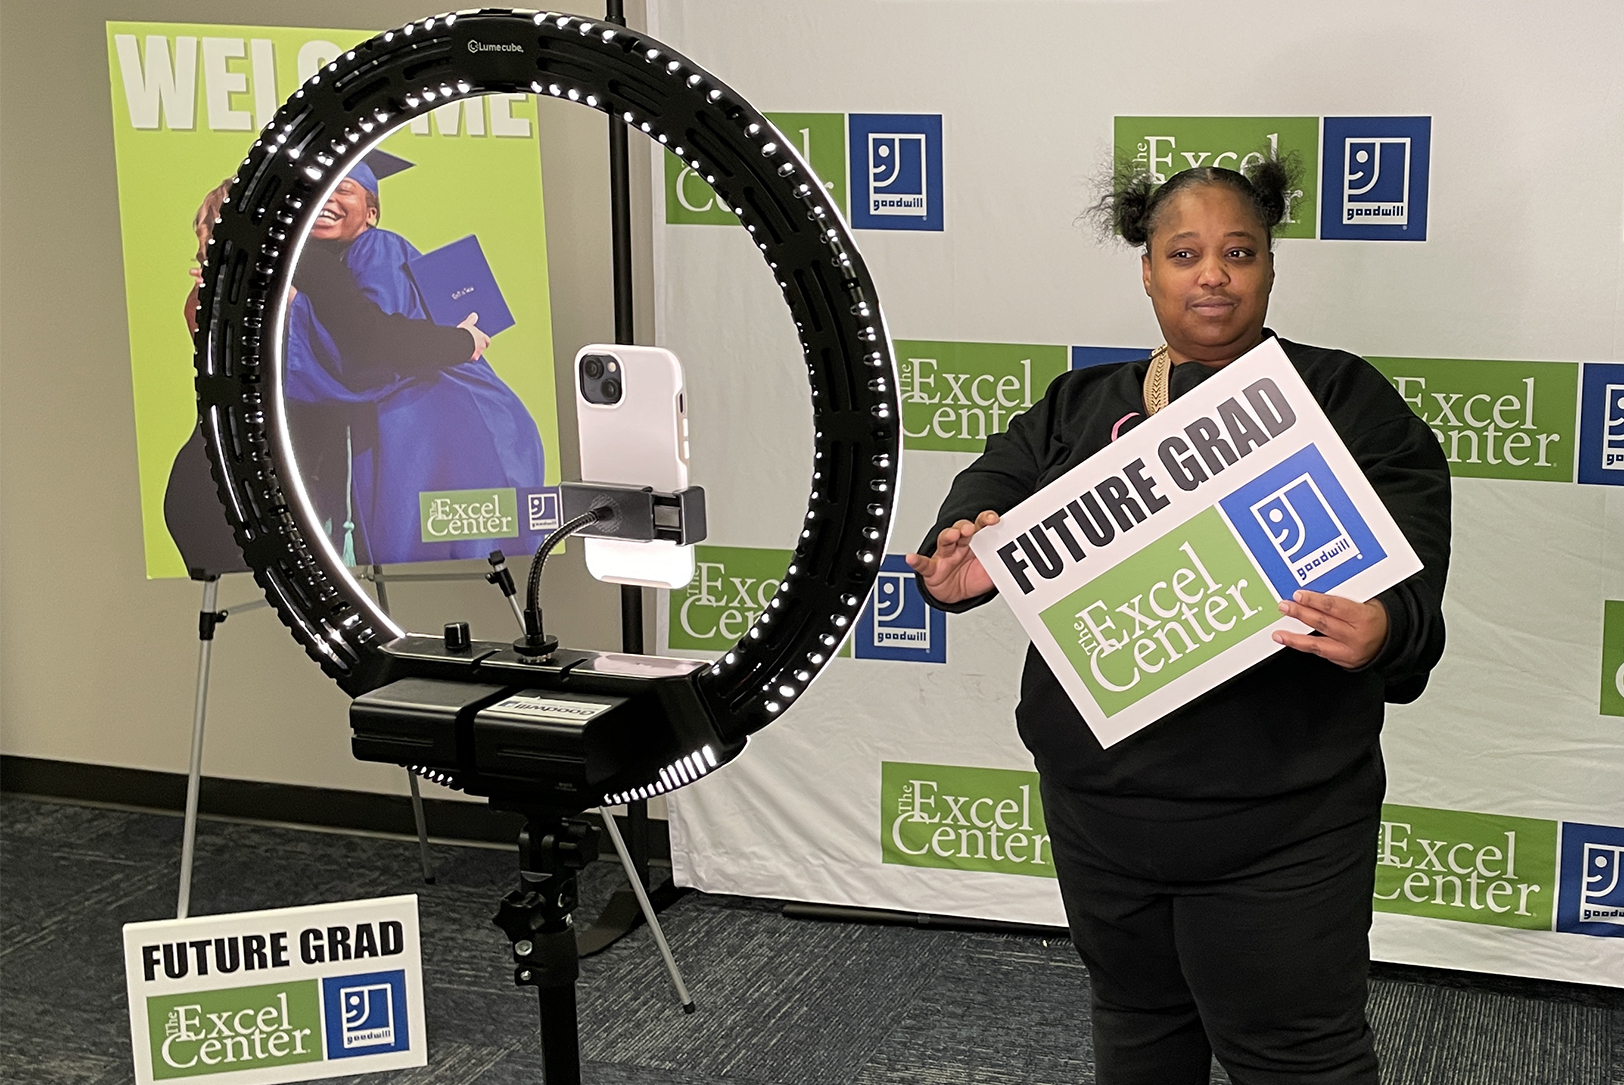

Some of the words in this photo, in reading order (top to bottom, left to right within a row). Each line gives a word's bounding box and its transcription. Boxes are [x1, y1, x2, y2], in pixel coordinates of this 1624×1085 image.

[873, 197, 923, 211] goodwill
[1347, 205, 1404, 221] goodwill
[908, 358, 1034, 408] Excel
[1392, 376, 1538, 430] Excel
[901, 392, 1026, 439] Cent
[434, 494, 501, 520] Excel
[997, 457, 1171, 596] FUTURE
[1157, 377, 1297, 492] GRAD
[427, 514, 512, 536] Center
[1296, 538, 1350, 581] goodwill
[695, 562, 781, 609] Exc
[1074, 540, 1223, 658] Excel
[877, 631, 927, 643] goodwill
[1073, 620, 1098, 656] The
[1090, 578, 1259, 692] Center
[898, 784, 912, 814] The
[907, 779, 1034, 831] Excel
[892, 811, 1050, 865] Center
[1377, 821, 1519, 880] Excel
[1583, 909, 1624, 919] good
[142, 932, 290, 982] FUTURE
[299, 920, 404, 965] GRAD
[165, 1011, 179, 1037] The
[173, 992, 293, 1042] Excel
[347, 1030, 391, 1045] goodwill
[161, 1027, 312, 1069] Center
